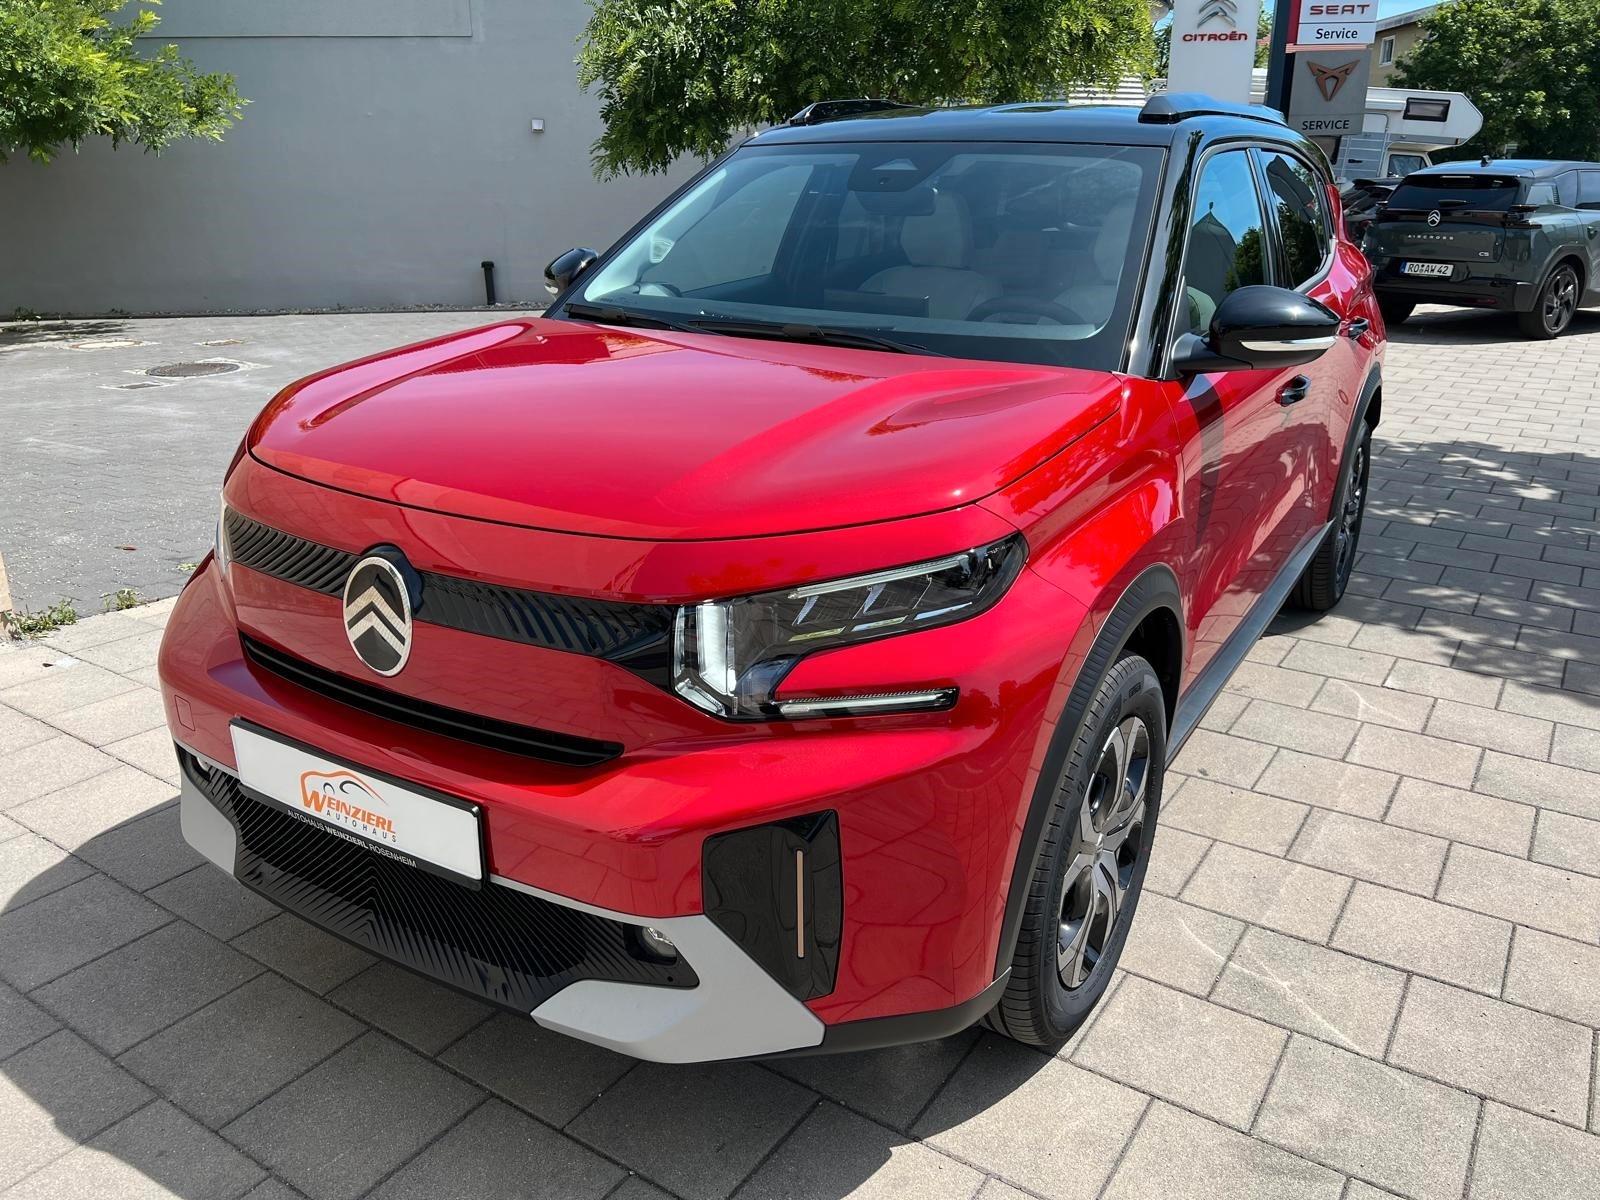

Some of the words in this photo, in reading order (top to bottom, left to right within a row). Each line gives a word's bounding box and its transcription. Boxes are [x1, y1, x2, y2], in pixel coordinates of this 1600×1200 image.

[1310, 4, 1370, 15] SEAT
[1182, 30, 1248, 42] CITROËN
[1316, 28, 1358, 40] Service
[1302, 119, 1350, 131] SERVICE
[1437, 265, 1449, 274] 42
[303, 790, 396, 834] WEINZIERL
[326, 809, 397, 843] AUTOHAUS
[287, 809, 325, 831] AUTOHAUS
[324, 825, 369, 850] WEINZIERL
[369, 843, 417, 869] ROSENHEIM
